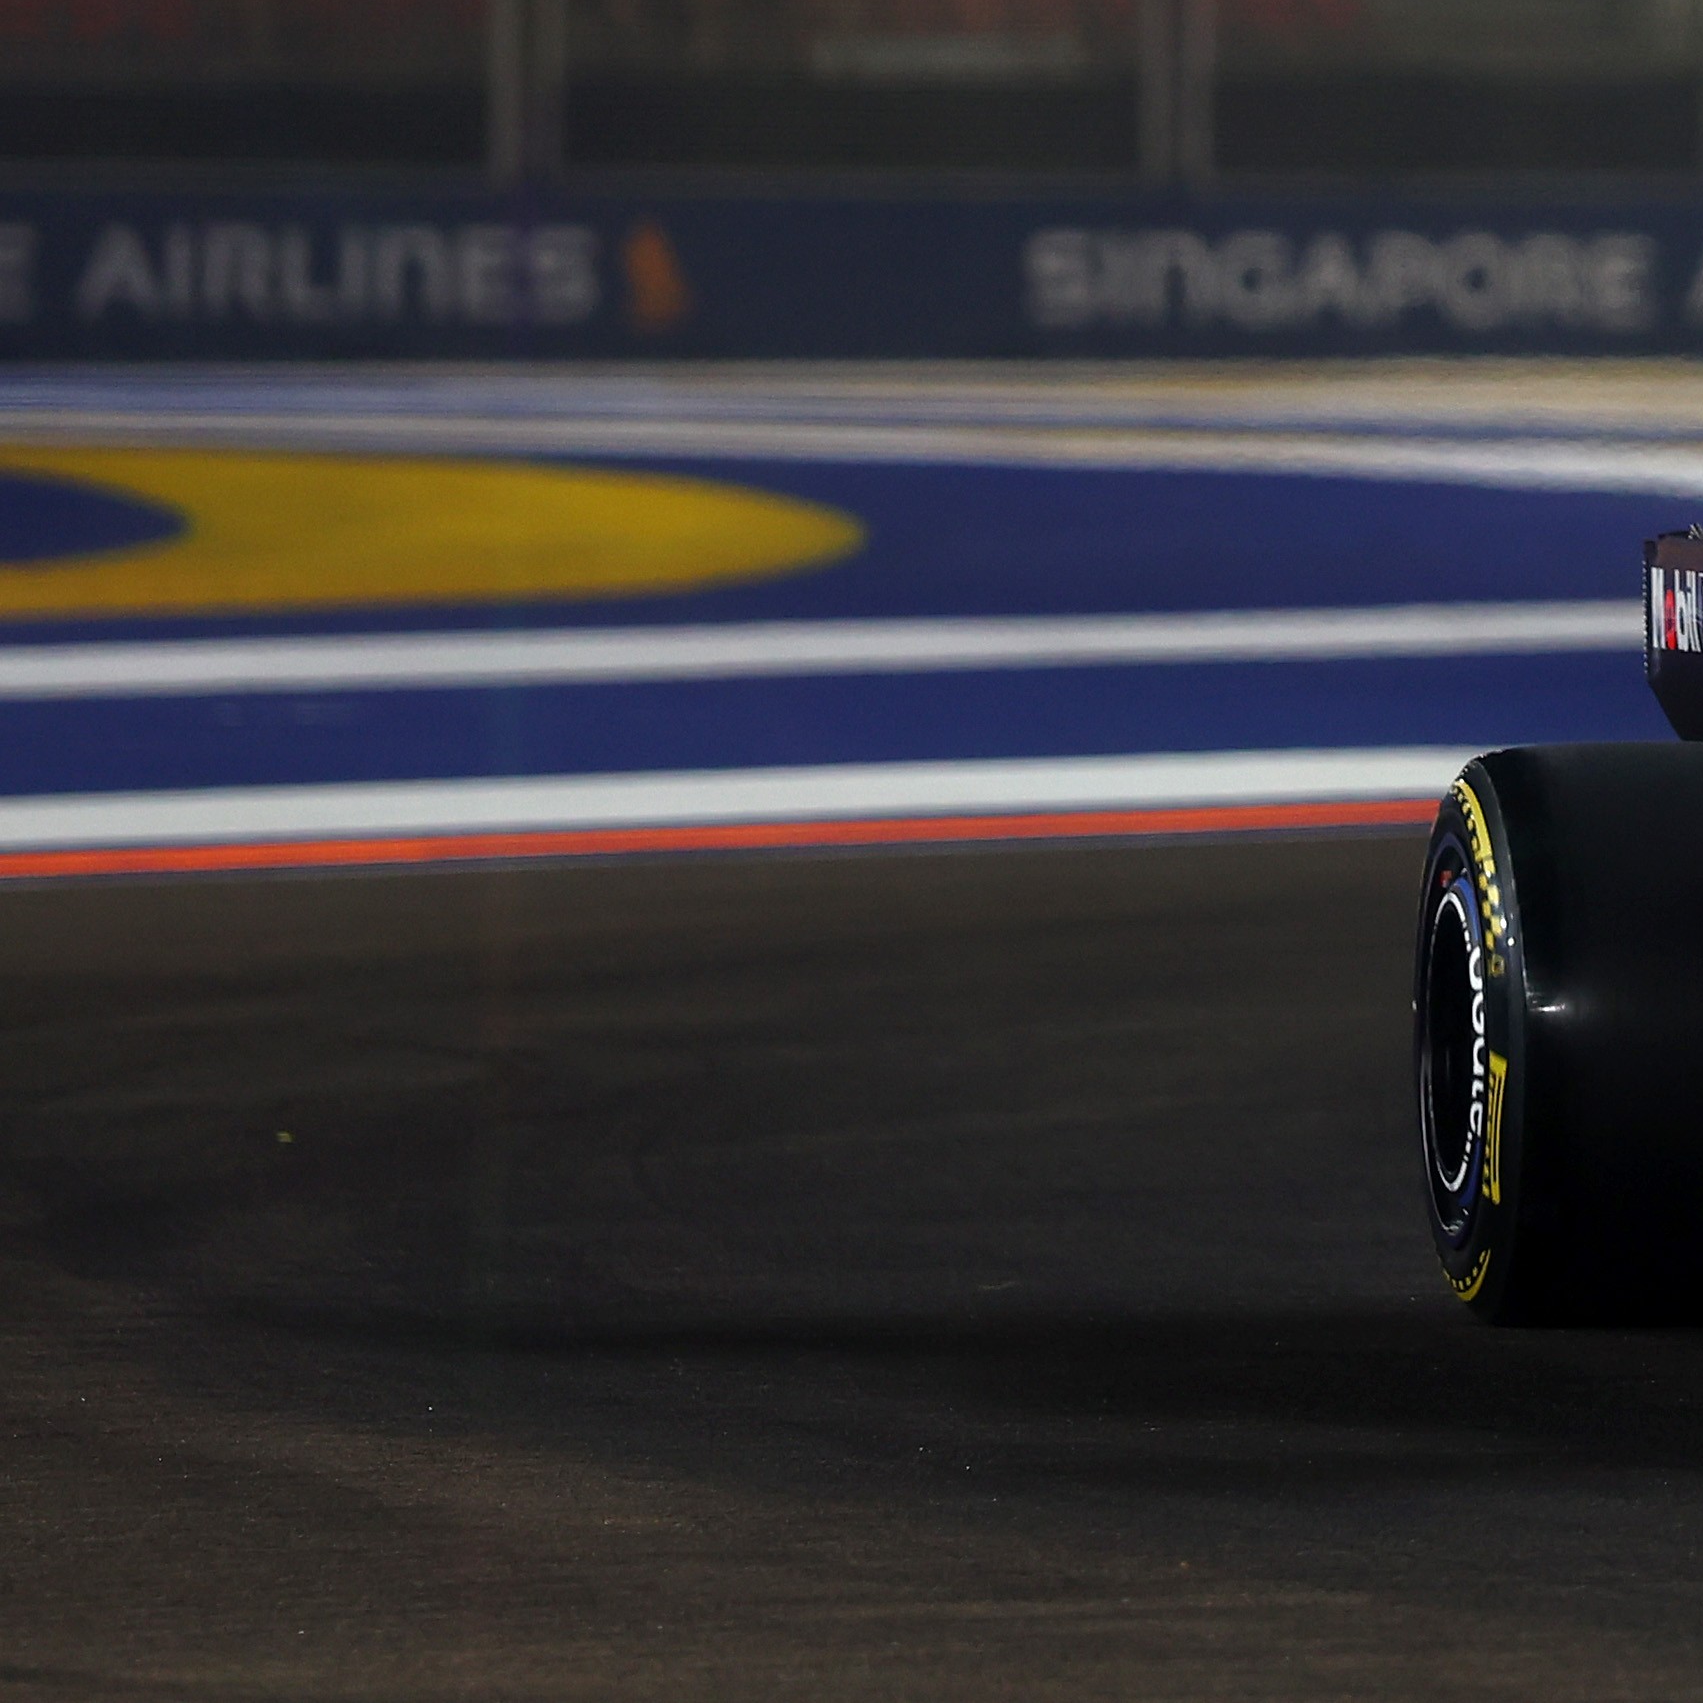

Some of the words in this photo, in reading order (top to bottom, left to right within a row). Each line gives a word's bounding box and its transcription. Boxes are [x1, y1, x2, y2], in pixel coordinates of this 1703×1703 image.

[76, 224, 597, 323] AIRLINES
[1022, 226, 1655, 330] SINGAPORE
[1651, 567, 1701, 654] Mobil
